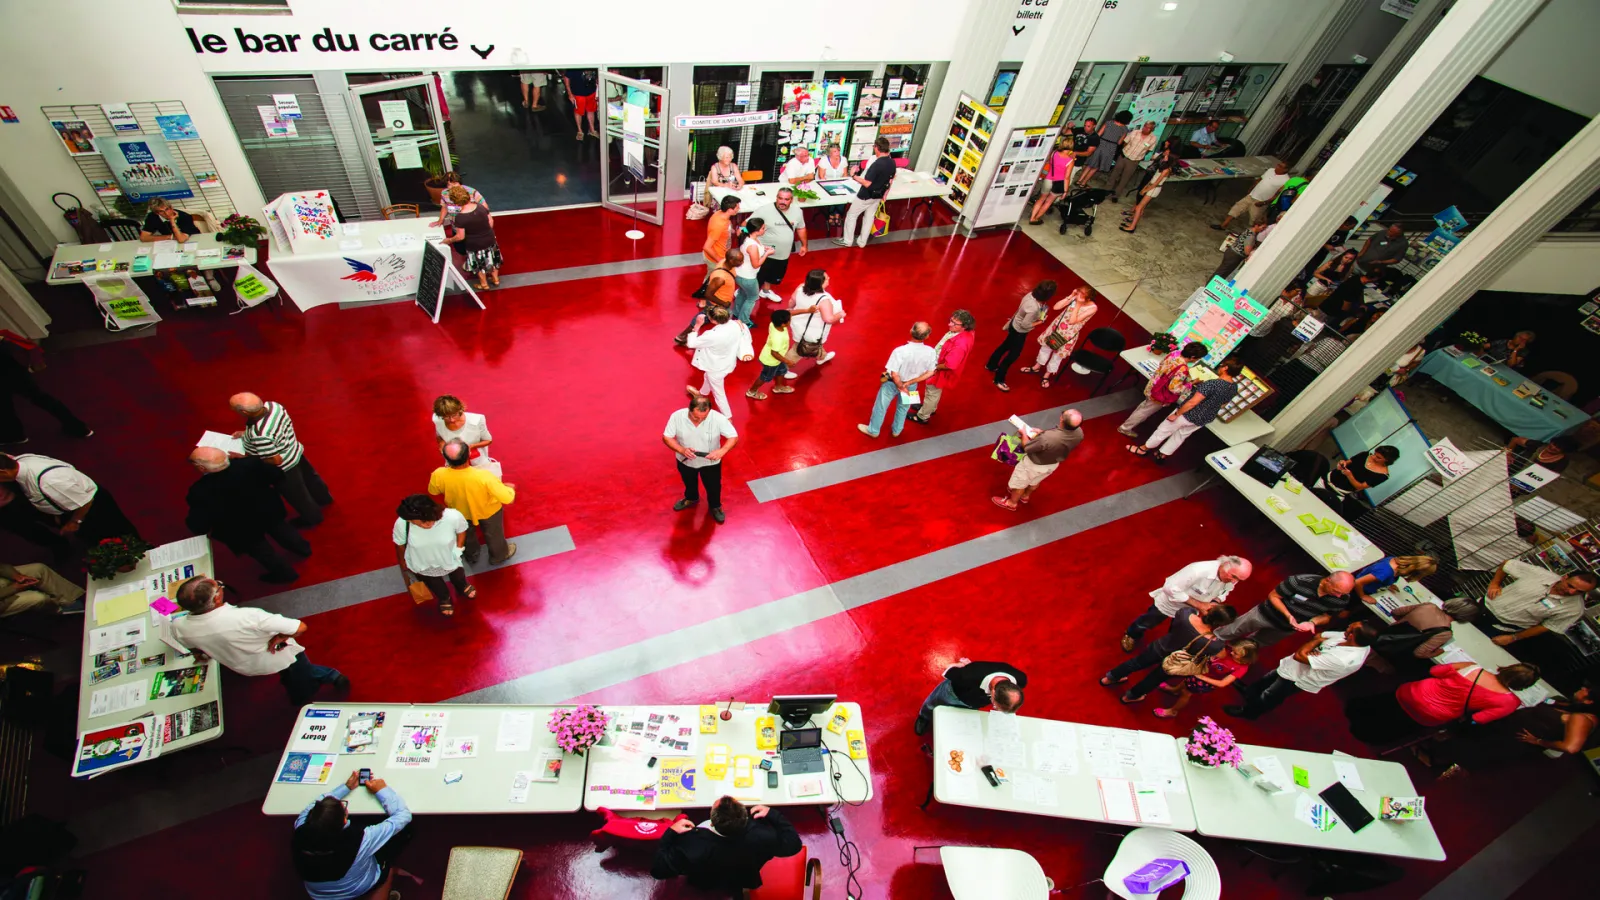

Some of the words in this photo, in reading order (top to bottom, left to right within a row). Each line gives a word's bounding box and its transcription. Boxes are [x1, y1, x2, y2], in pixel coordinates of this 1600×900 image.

[185, 27, 228, 53] le
[234, 27, 301, 53] bar
[312, 27, 360, 52] du
[369, 27, 459, 51] carré
[1525, 471, 1544, 482] Asco
[309, 725, 326, 733] club
[300, 732, 327, 742] Rotary
